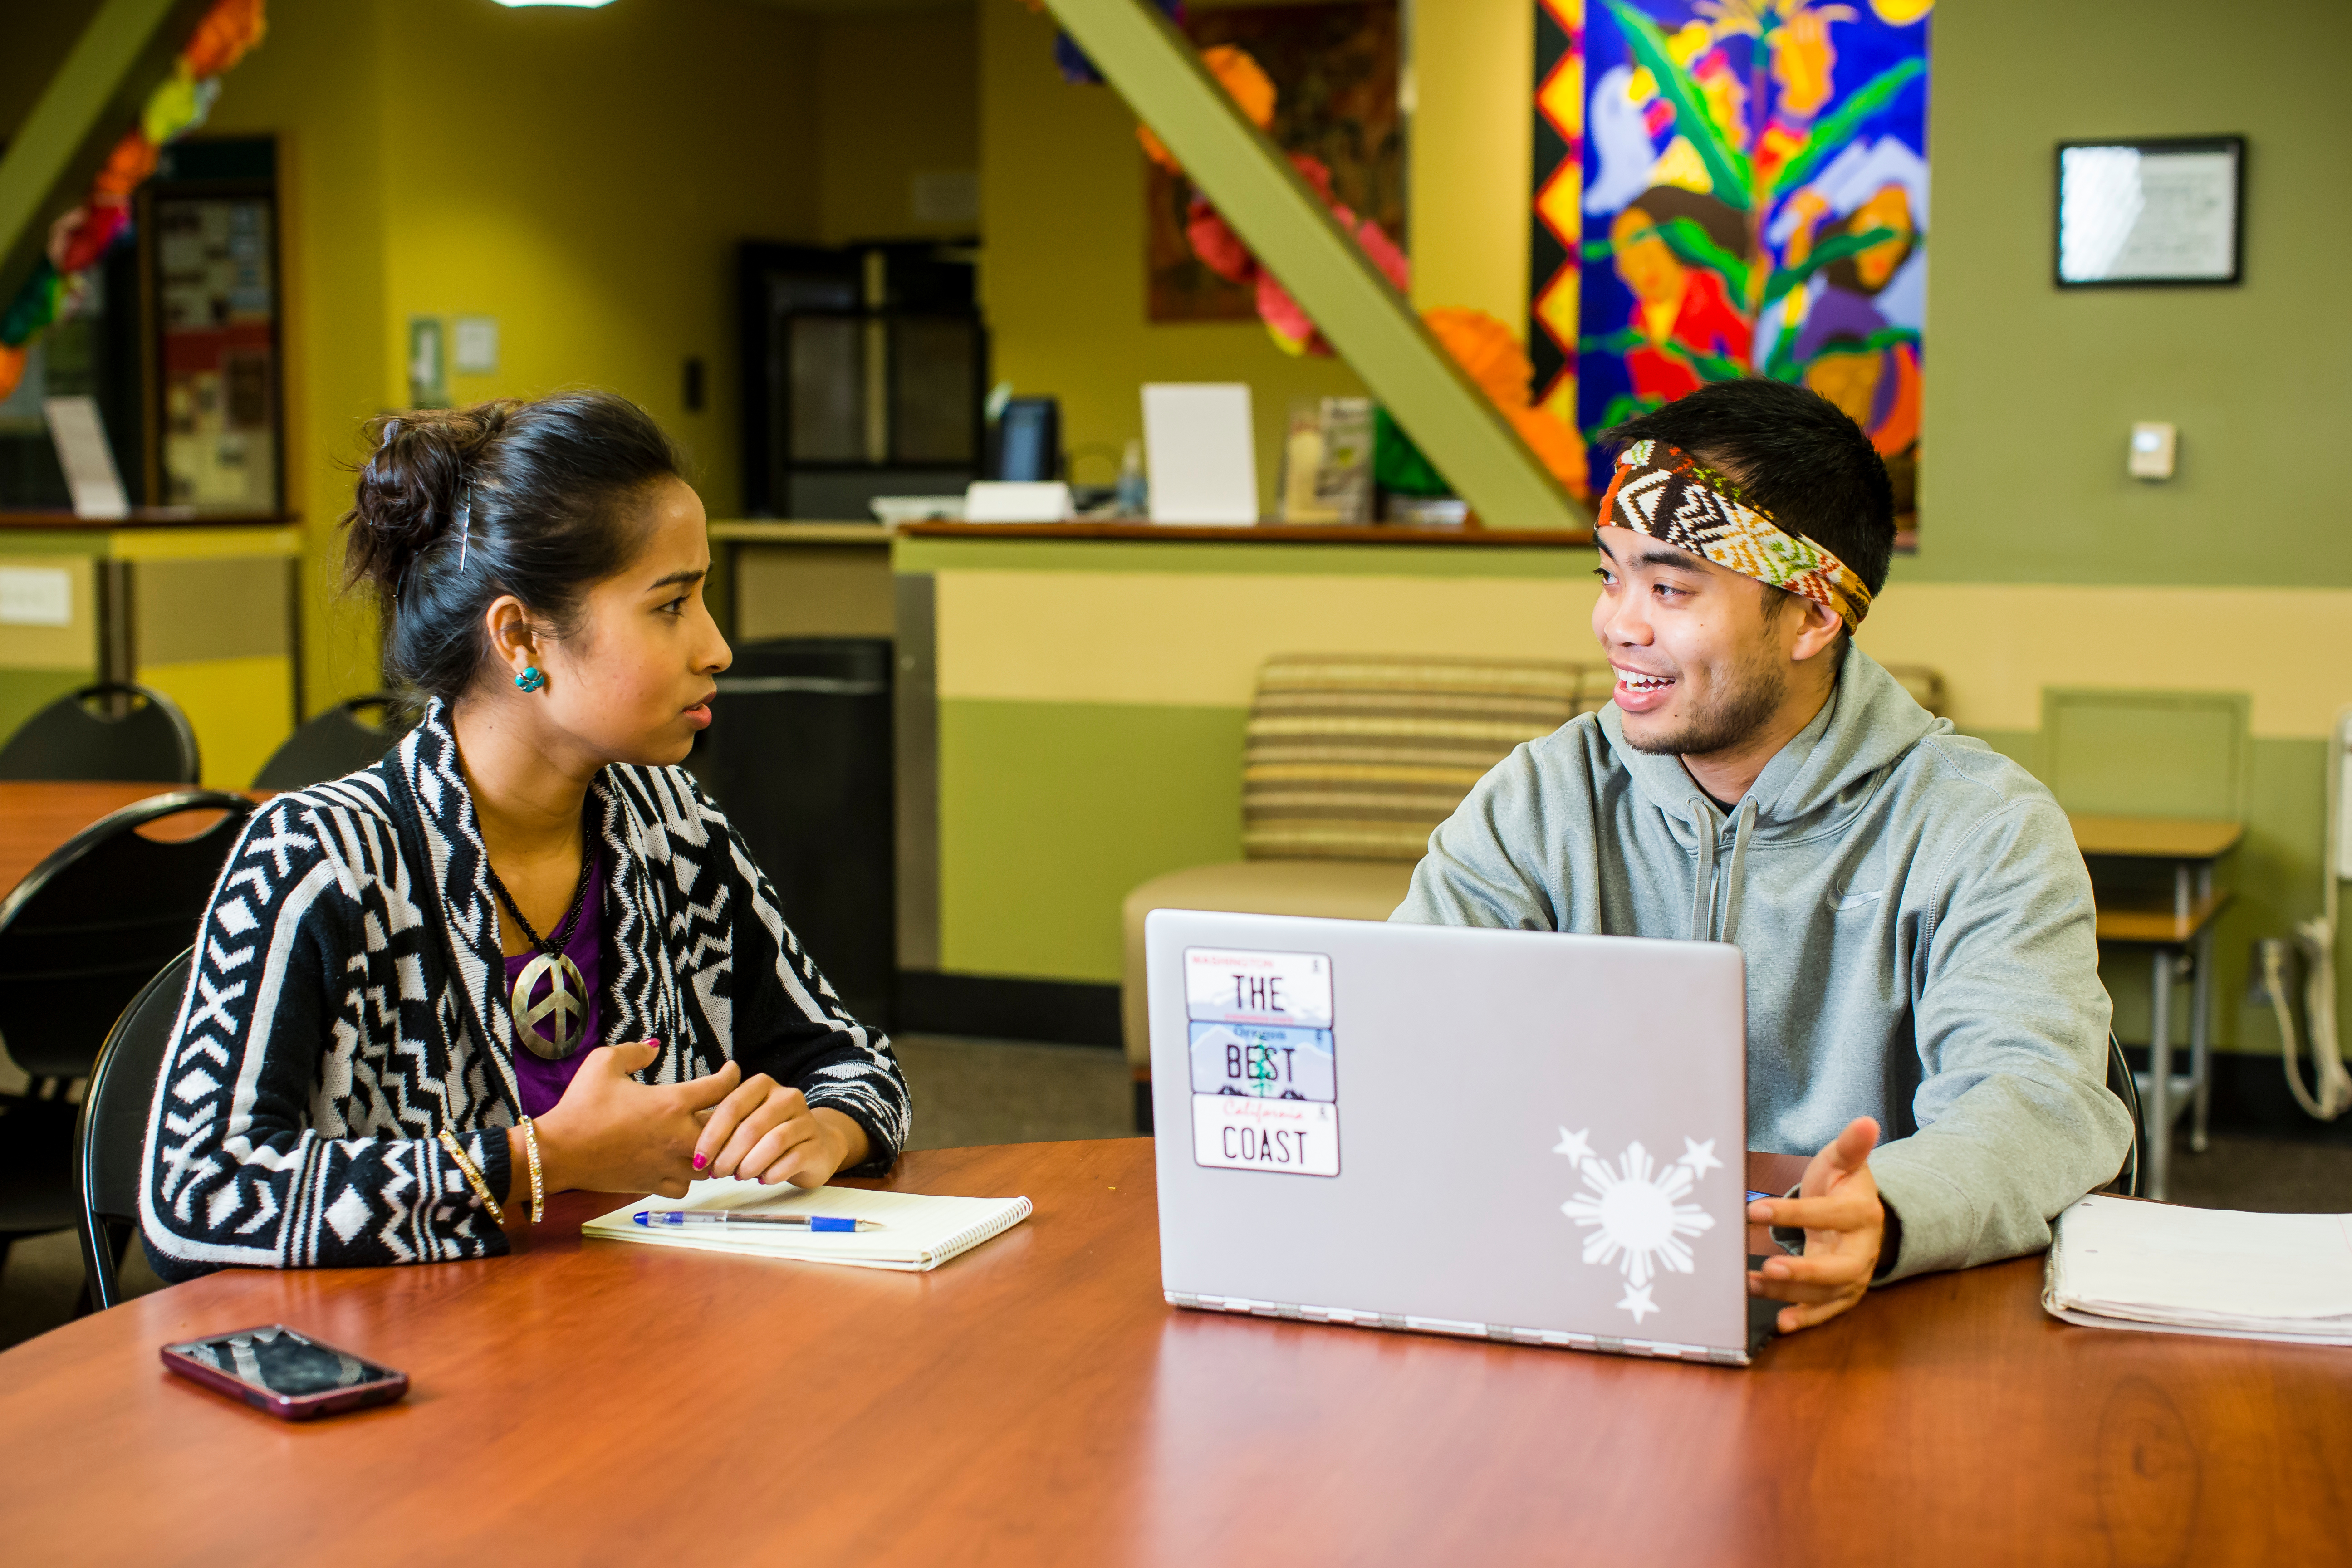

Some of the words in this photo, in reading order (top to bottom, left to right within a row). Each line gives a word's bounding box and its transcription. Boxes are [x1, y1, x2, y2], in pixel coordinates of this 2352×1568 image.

[1231, 974, 1285, 1012] THE
[1227, 1044, 1295, 1083] BEST
[1223, 1099, 1303, 1123] California
[1223, 1126, 1307, 1165] COAST
